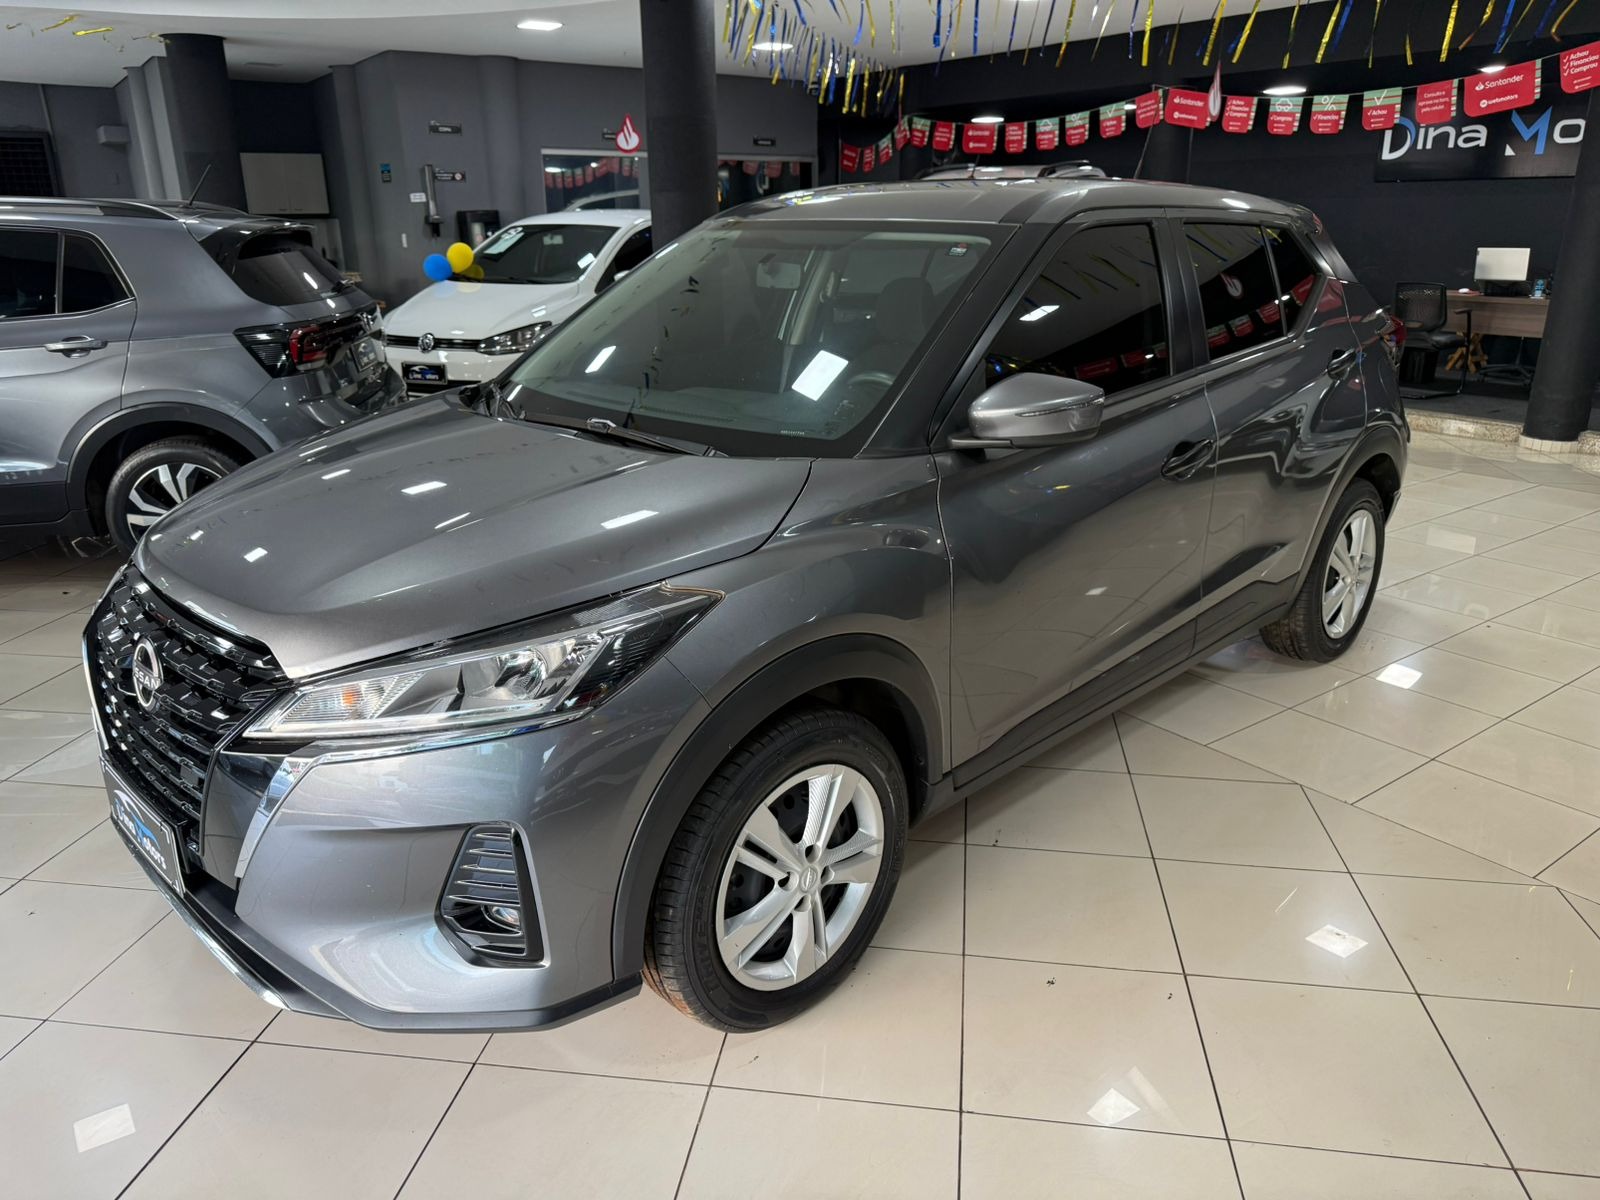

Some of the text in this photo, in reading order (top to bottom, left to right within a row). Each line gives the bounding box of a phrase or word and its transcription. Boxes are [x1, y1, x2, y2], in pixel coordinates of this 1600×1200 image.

[1570, 50, 1589, 60] Achou
[1570, 54, 1600, 67] Financiou
[1570, 62, 1598, 74] Comprou
[1485, 74, 1524, 89] Santander
[1488, 94, 1518, 105] webmotors
[1382, 116, 1488, 161] Dina
[134, 667, 159, 689] SSAN
